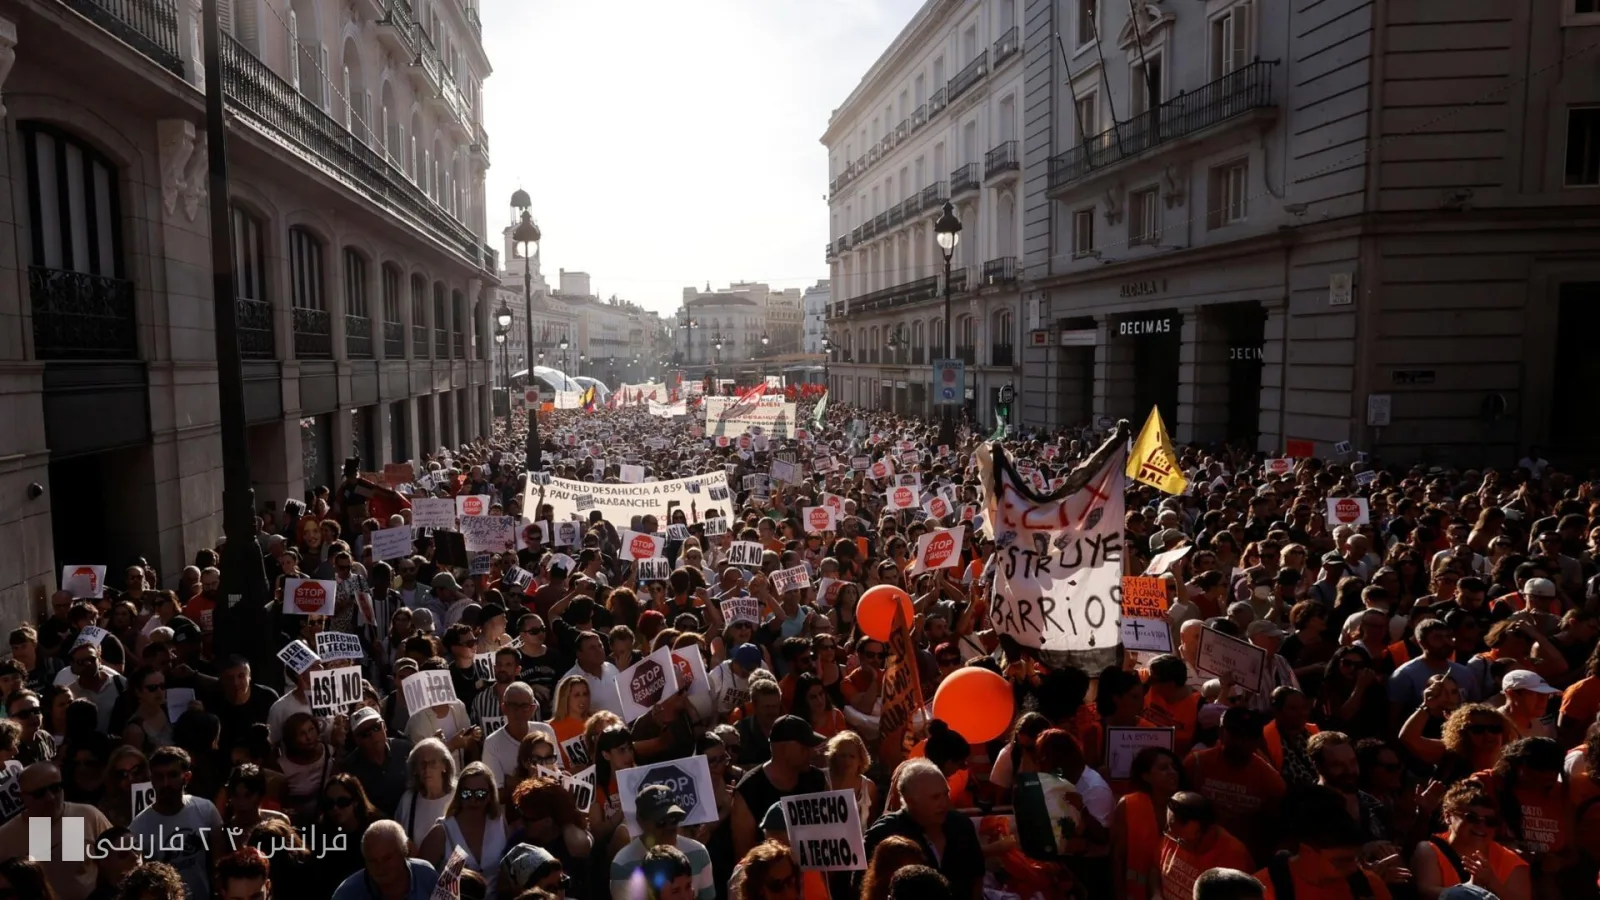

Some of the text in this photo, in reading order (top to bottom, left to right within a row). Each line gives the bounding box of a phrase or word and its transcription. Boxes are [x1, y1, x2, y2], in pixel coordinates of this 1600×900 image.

[1120, 319, 1171, 335] DECIMAS
[553, 474, 725, 495] OKFIELD DESAHUCIA A 859 MILIAS
[550, 490, 569, 499] PAU
[594, 497, 661, 507] ARABANCHEL
[719, 519, 727, 533] NO
[633, 540, 654, 549] STOP
[928, 540, 953, 552] STOP
[749, 545, 762, 564] NO
[657, 561, 668, 578] NO
[773, 566, 806, 581] DERECHO
[783, 573, 808, 587] TECHO
[297, 588, 324, 596] STOP
[722, 598, 757, 611] DERECHO
[1133, 597, 1160, 607] CASAS
[725, 607, 757, 619] A TECHO
[317, 633, 358, 644] DERECHO
[319, 642, 360, 655] A TECHO
[289, 658, 299, 668] A
[674, 661, 687, 673] OP
[632, 664, 661, 691] STOP
[313, 670, 361, 706] ASÍ, NO
[634, 676, 666, 703] DESAHUCIOS
[787, 796, 848, 826] DERECHO
[800, 838, 858, 866] A TECHO.
